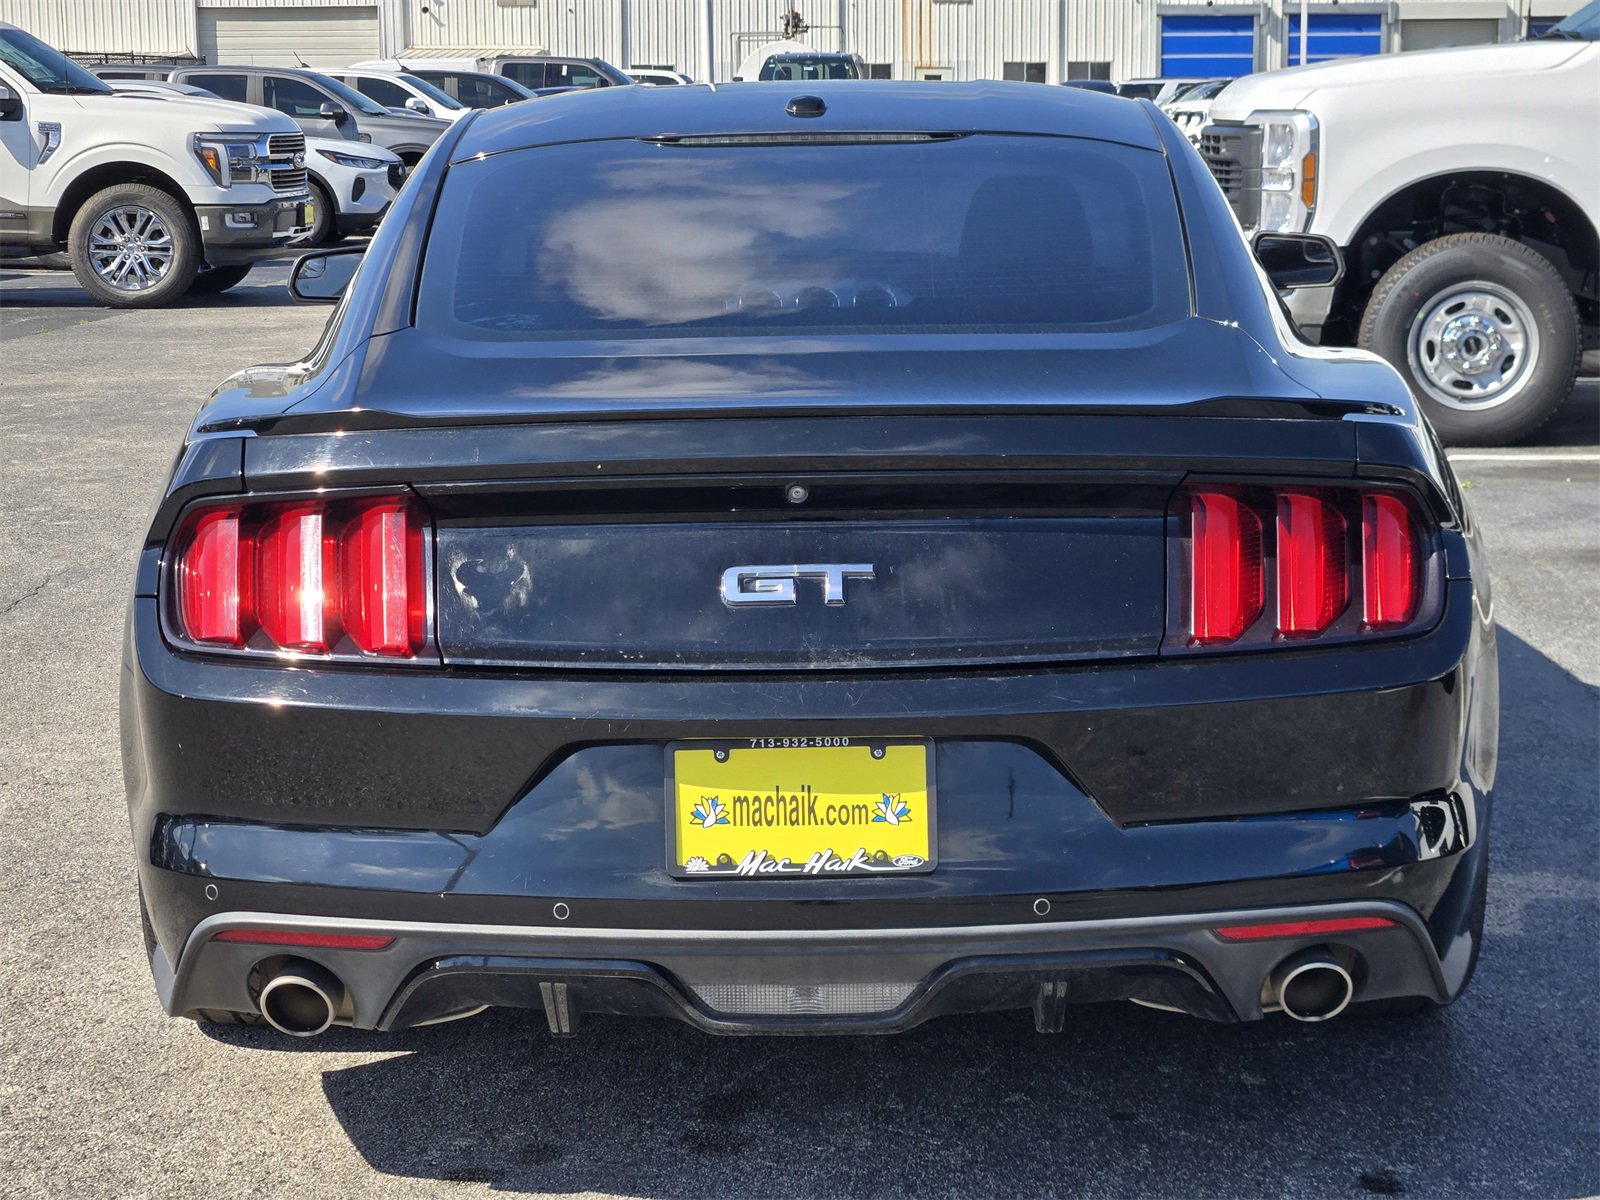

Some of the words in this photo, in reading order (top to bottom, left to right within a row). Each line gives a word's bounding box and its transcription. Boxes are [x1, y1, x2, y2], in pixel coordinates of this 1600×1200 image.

[721, 563, 876, 607] GT
[750, 737, 850, 748] 713-932-5000
[733, 785, 869, 826] machaik.com
[736, 849, 801, 876] Mac
[804, 847, 872, 875] Haik
[897, 855, 920, 866] Ford
